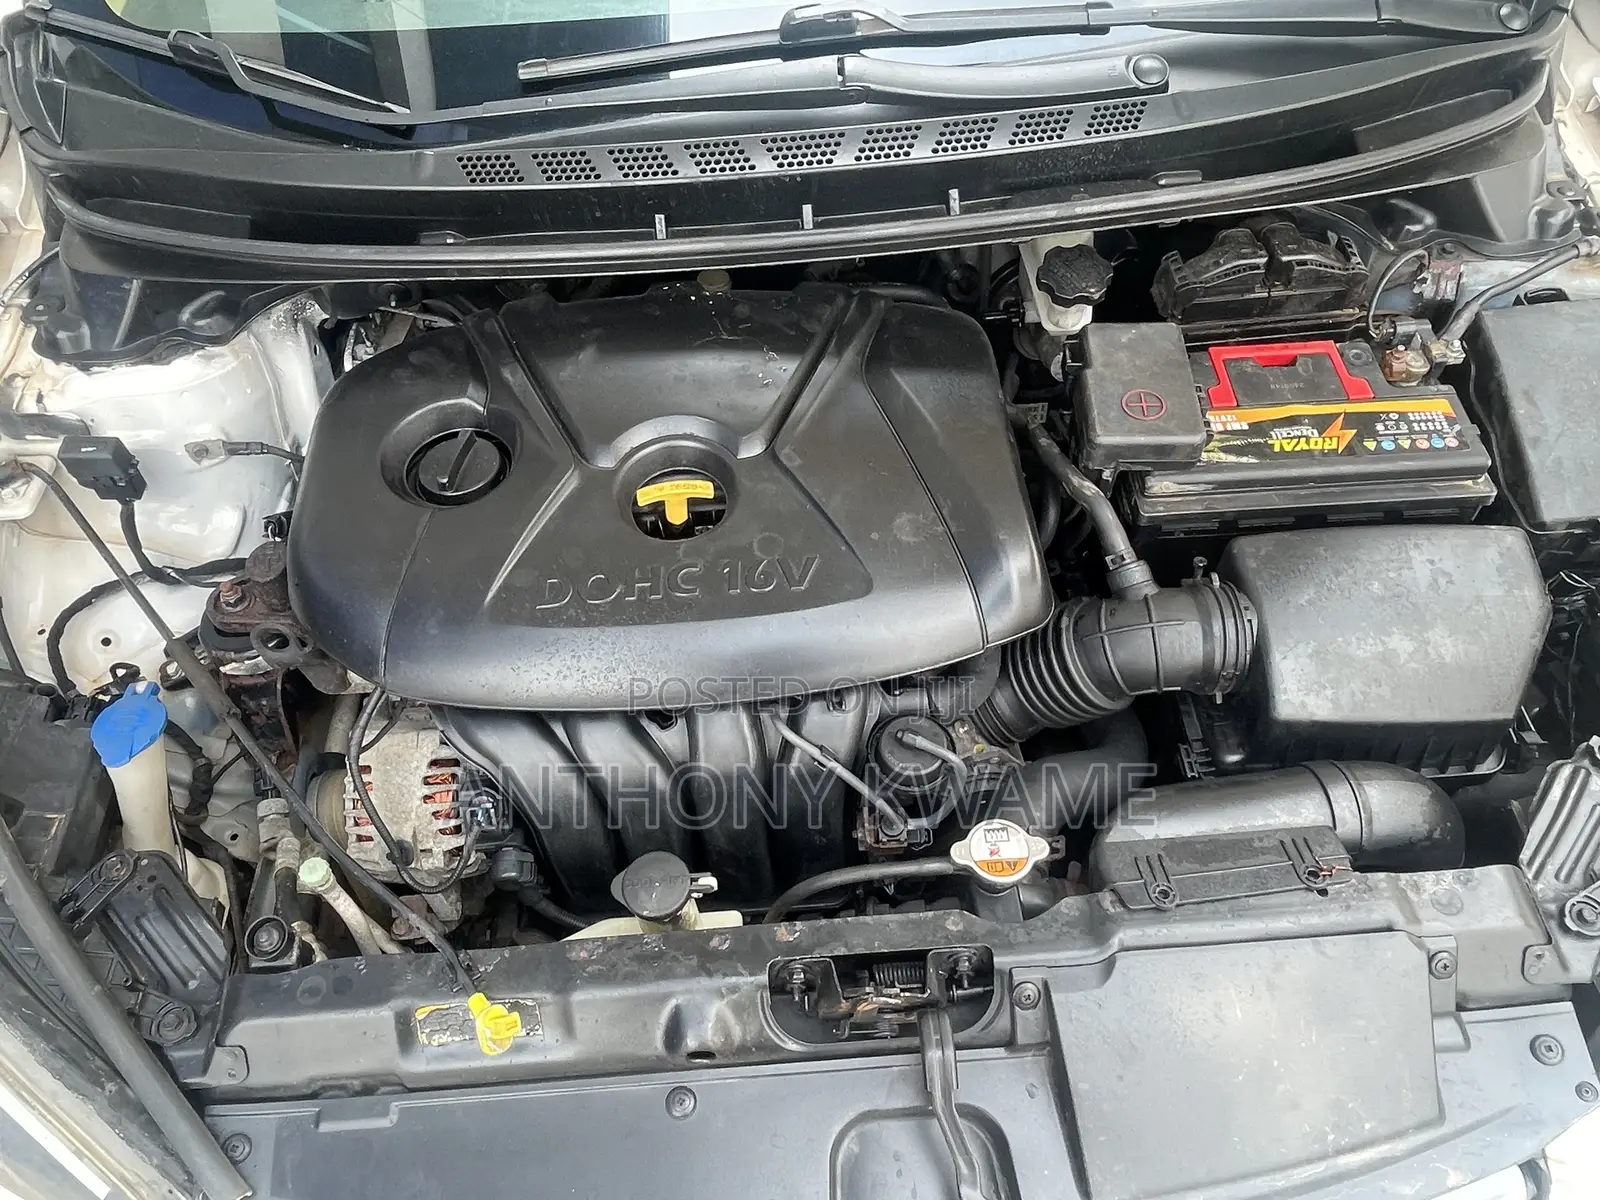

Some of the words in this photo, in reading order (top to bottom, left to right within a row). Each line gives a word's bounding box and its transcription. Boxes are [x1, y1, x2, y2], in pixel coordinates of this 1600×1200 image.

[1267, 435, 1341, 453] ROYAL
[535, 563, 702, 610] DOHC
[722, 553, 821, 595] 16V
